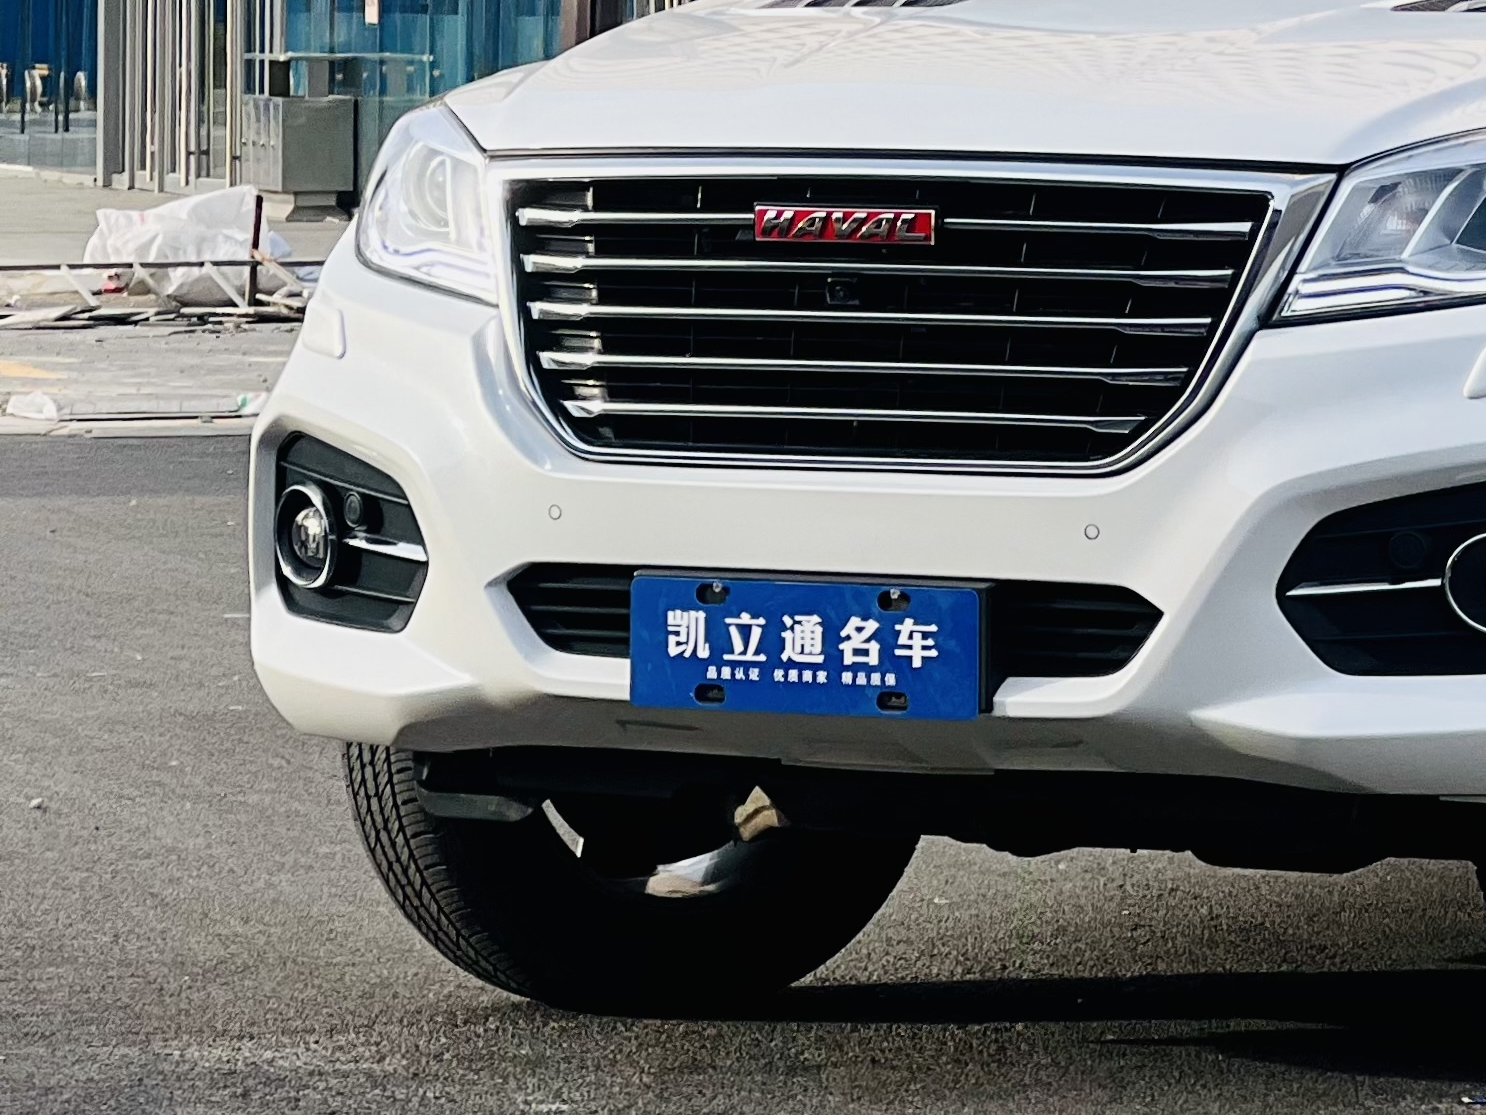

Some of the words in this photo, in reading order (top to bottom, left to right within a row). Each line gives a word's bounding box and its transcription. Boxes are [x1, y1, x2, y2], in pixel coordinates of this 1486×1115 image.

[761, 209, 926, 240] HAVAL
[666, 609, 939, 669] 凯立通名车
